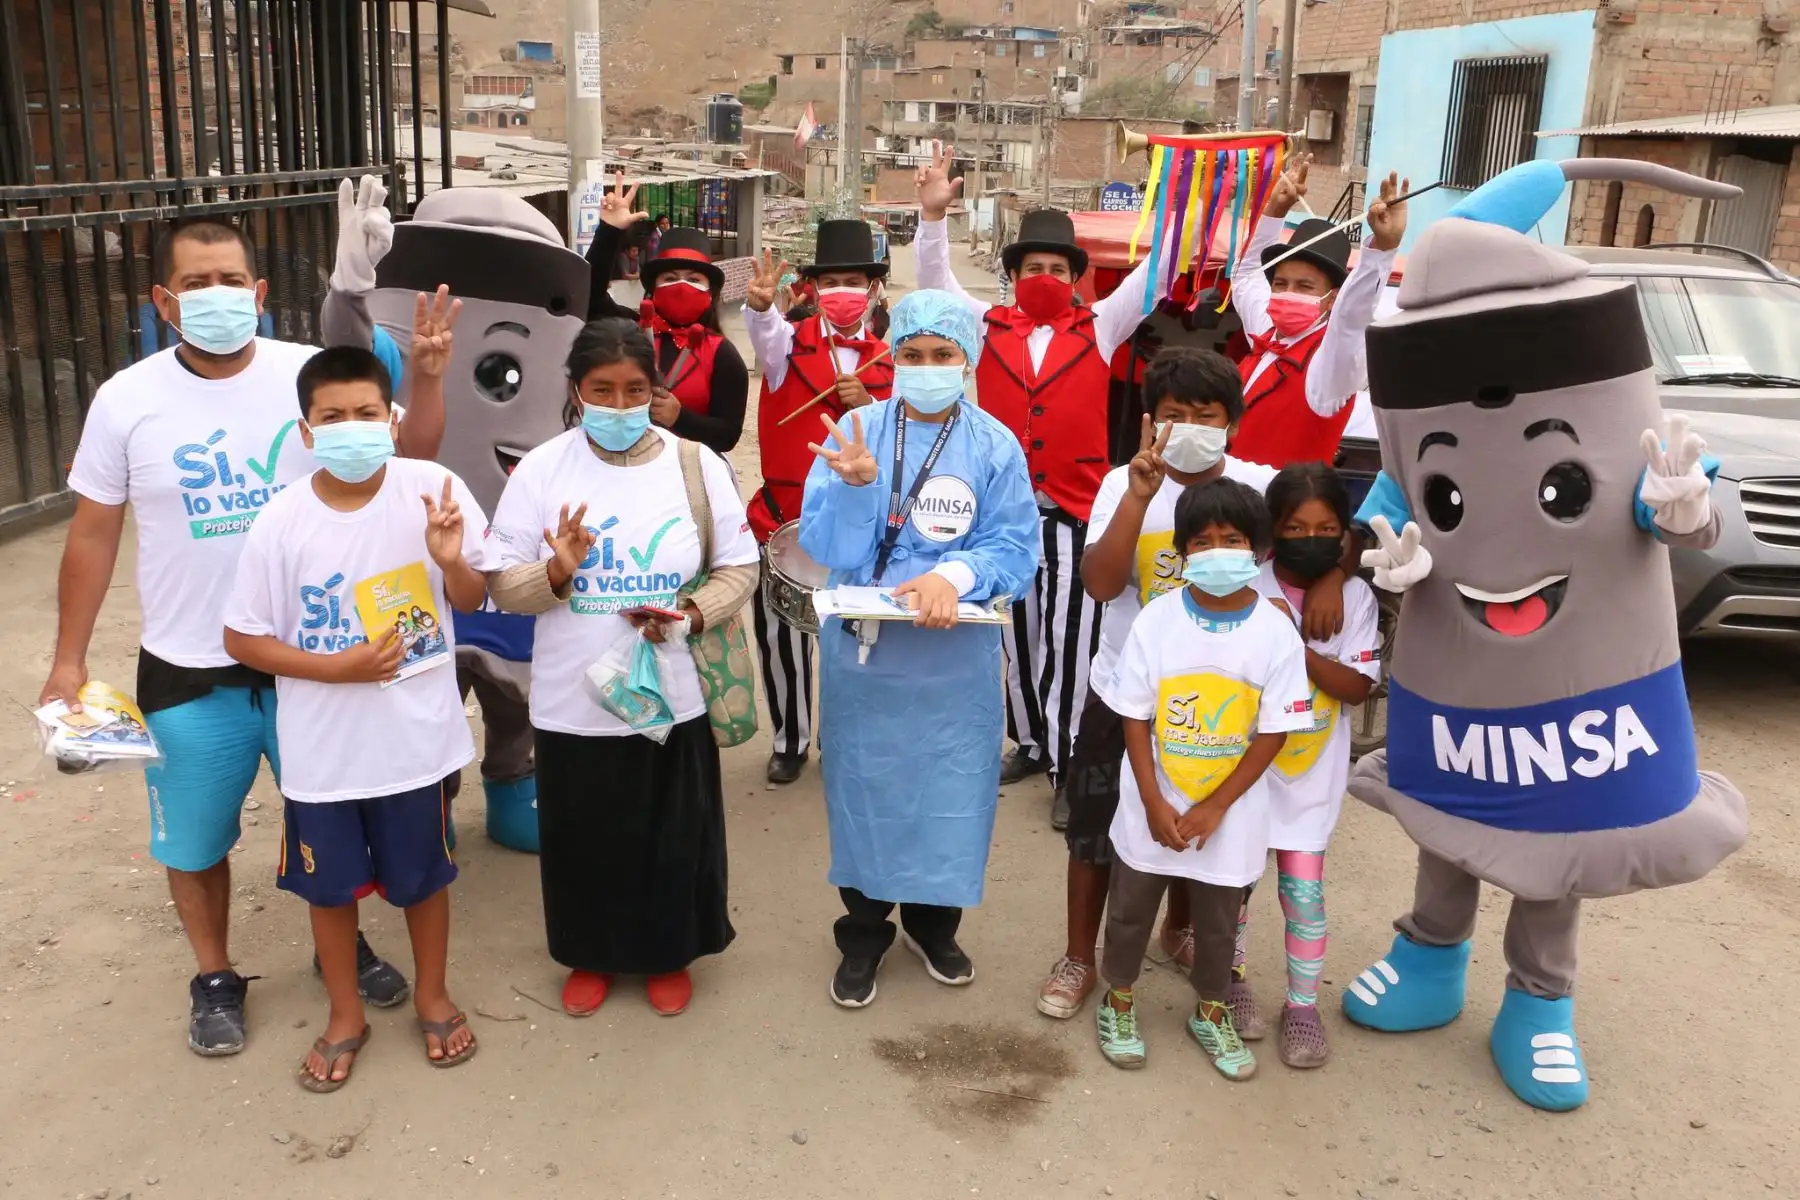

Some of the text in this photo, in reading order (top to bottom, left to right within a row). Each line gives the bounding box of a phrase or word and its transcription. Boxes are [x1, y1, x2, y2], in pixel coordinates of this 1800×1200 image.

[897, 420, 904, 428] DE
[895, 428, 904, 461] MINISTERIO
[924, 415, 955, 470] MINISTERIO DE SALUD
[173, 428, 246, 489] Sí,
[181, 492, 212, 517] lo
[913, 496, 974, 517] MINSA
[202, 513, 255, 535] Protejo
[572, 571, 682, 594] o vacuno
[300, 572, 350, 633] Sí,
[577, 598, 622, 615] Protejo
[1166, 691, 1201, 733] Sí,
[1192, 731, 1243, 747] vacuno
[1432, 704, 1660, 786] MINSA
